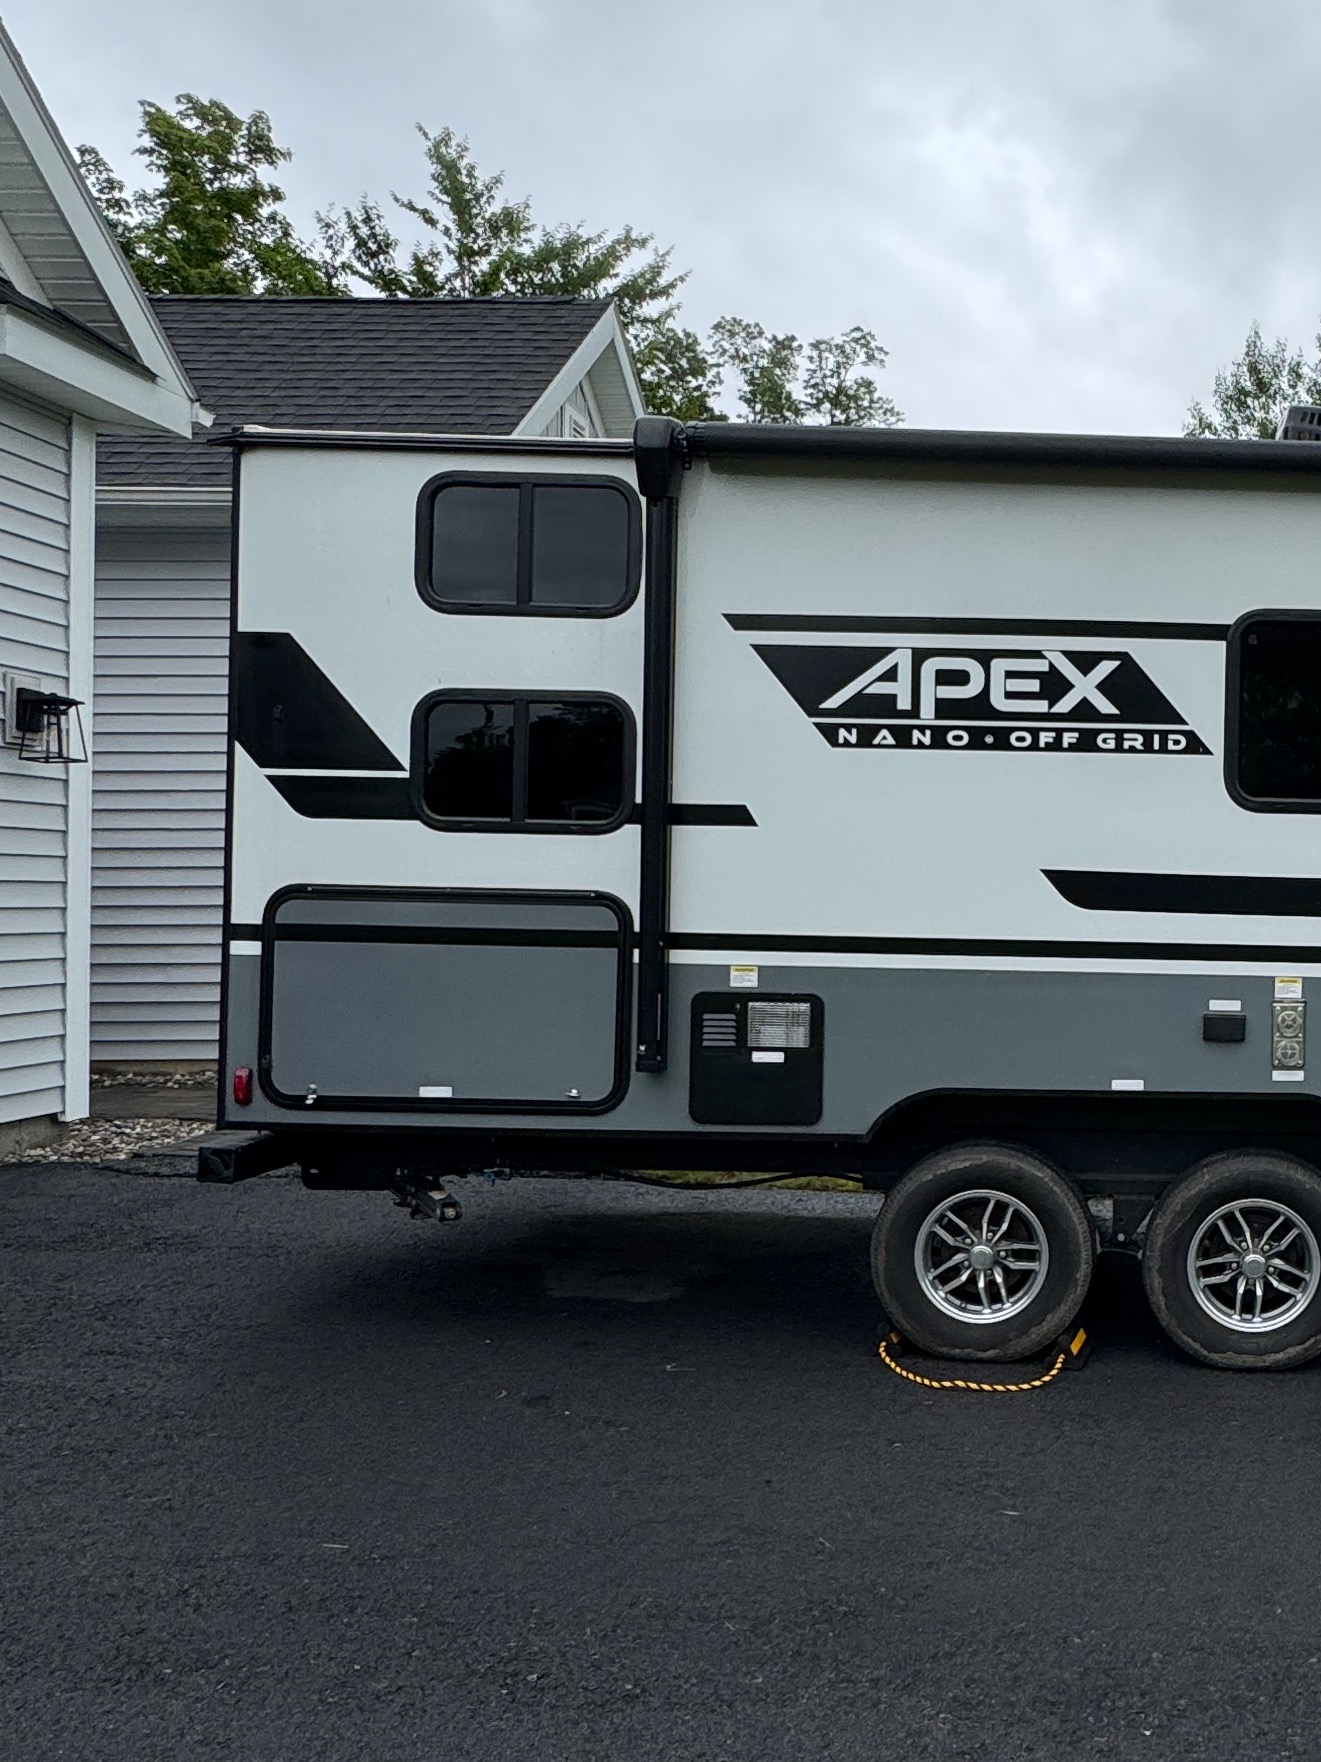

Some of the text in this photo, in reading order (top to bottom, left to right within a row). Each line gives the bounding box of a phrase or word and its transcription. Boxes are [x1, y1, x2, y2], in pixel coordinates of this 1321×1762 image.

[818, 648, 1121, 719] APEX
[838, 728, 1187, 751] NANO OFF GRID
